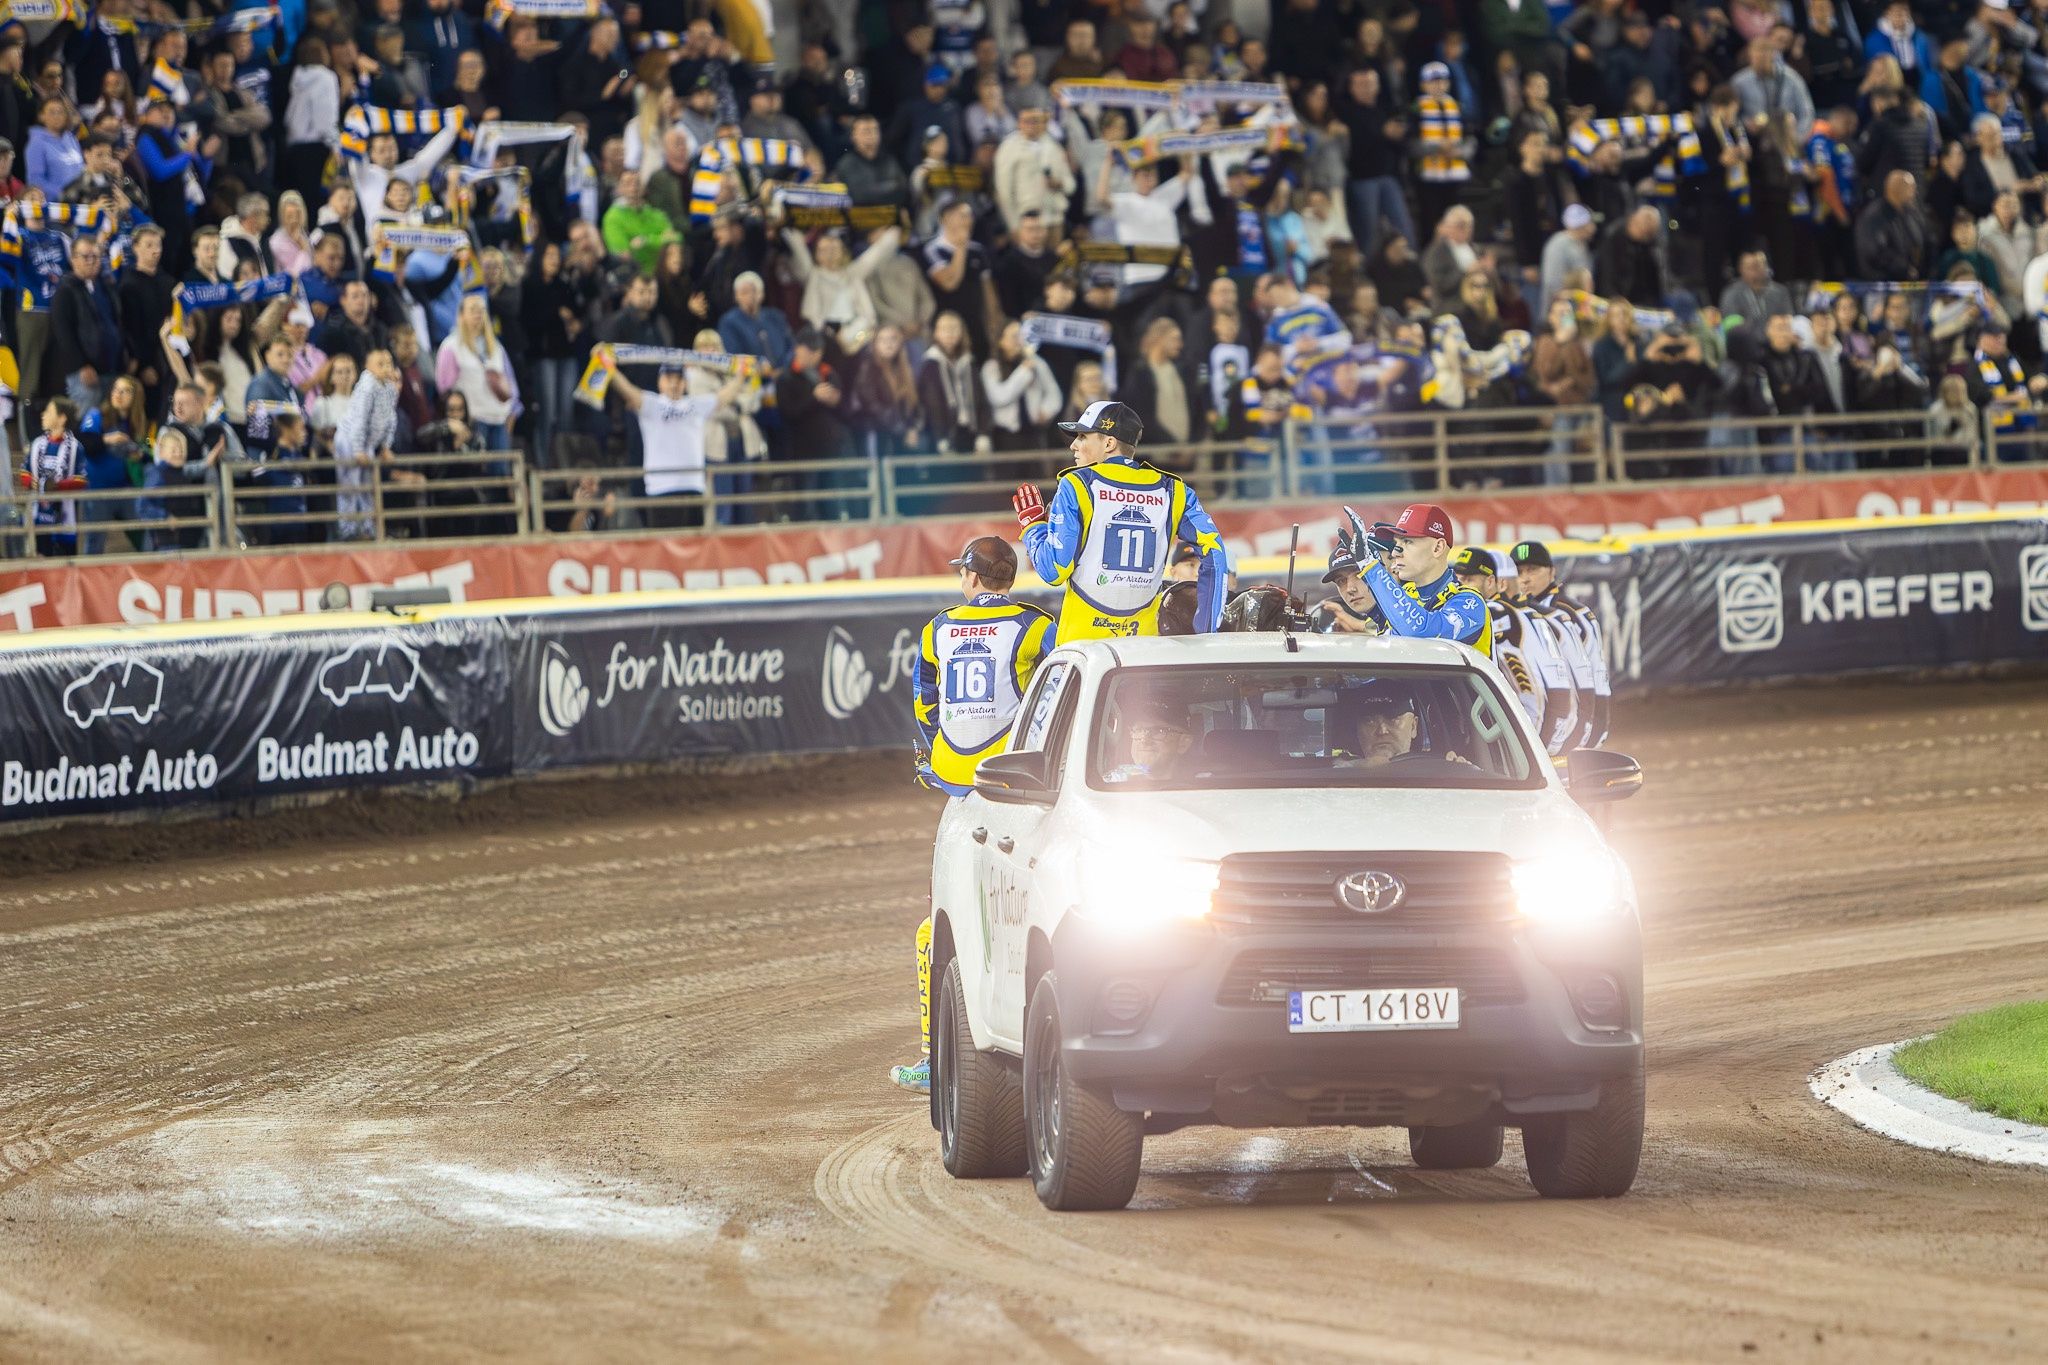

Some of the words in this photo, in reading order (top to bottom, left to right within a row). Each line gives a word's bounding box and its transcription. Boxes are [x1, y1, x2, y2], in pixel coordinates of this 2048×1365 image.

[1099, 489, 1163, 506] BLÖDORN
[1117, 528, 1145, 568] 11
[1376, 569, 1425, 626] NICOLAUS
[1393, 603, 1418, 632] BANK
[1800, 570, 1994, 625] KAEFER
[950, 626, 998, 638] DEREK
[597, 641, 656, 708] for
[661, 638, 784, 688] Nature
[879, 628, 918, 693] fo
[952, 660, 987, 699] 16
[678, 692, 784, 723] Solutions
[257, 732, 388, 782] Budmat
[394, 725, 480, 771] Auto
[2, 756, 134, 806] Budmat
[137, 749, 219, 794] Auto
[1309, 994, 1347, 1022] CT
[1362, 992, 1449, 1022] 1618V
